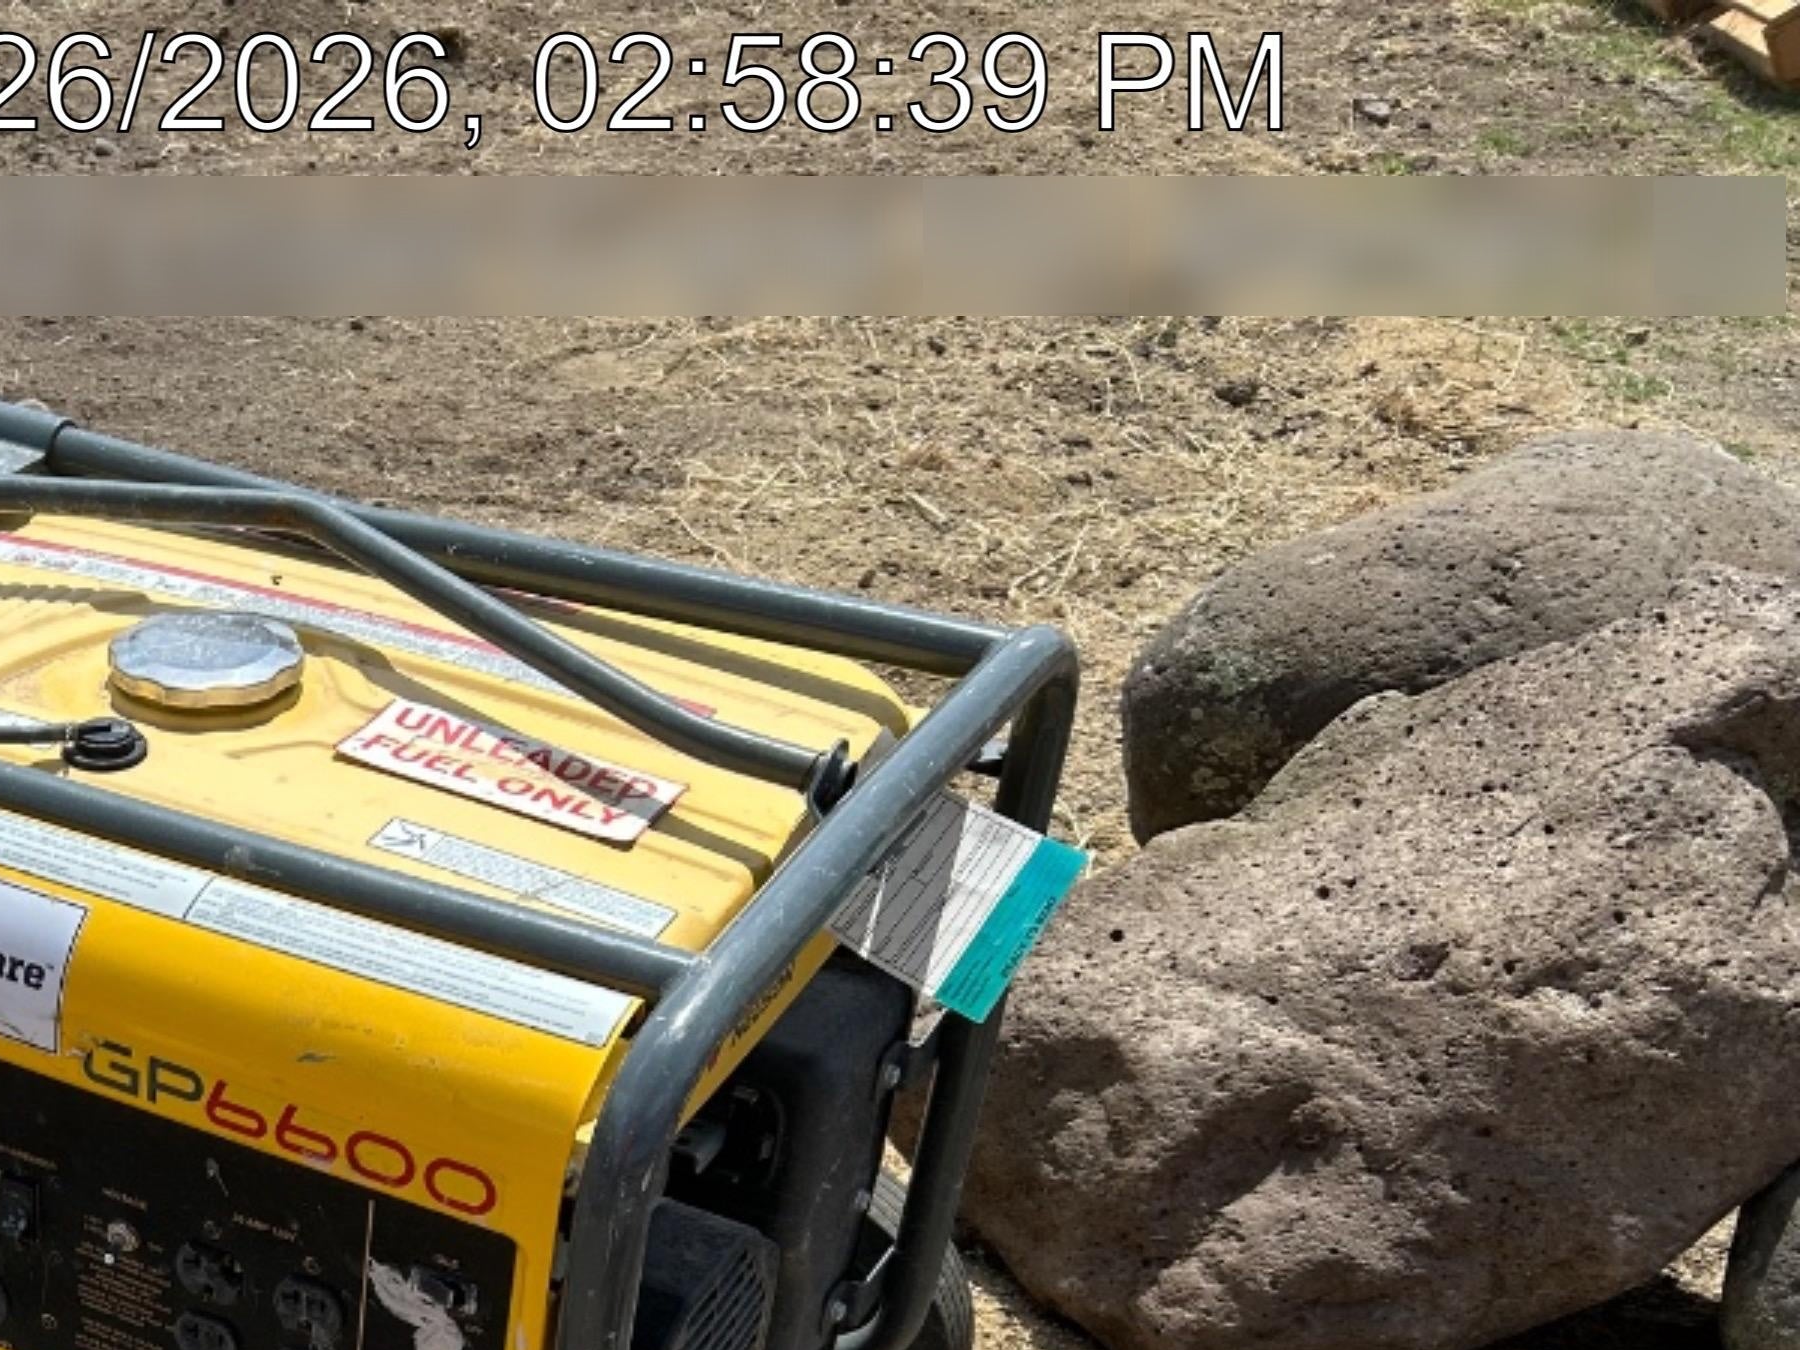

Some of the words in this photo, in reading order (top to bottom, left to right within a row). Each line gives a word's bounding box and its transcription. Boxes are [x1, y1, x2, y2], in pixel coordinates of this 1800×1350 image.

[361, 733, 479, 783] FUEL
[496, 775, 630, 828] ONLY
[394, 705, 659, 804] UNLEADED
[82, 1037, 498, 1216] GP6600
